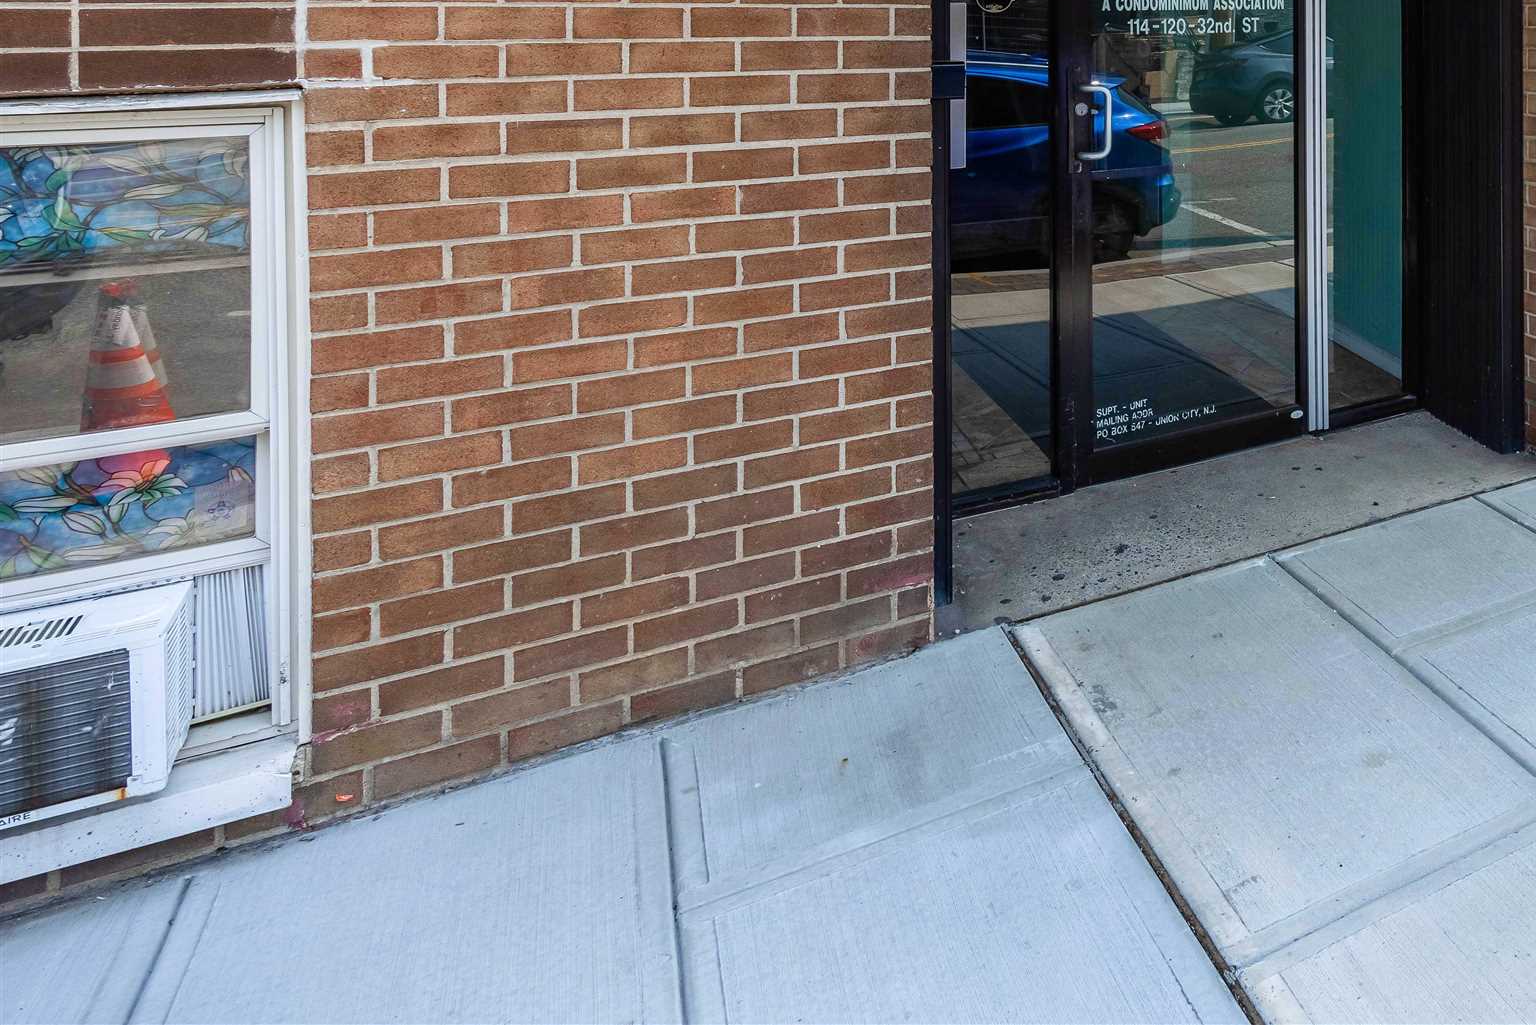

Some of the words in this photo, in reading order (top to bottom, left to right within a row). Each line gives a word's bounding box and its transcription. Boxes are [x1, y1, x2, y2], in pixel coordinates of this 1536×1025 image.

[1241, 16, 1260, 33] ST
[1096, 405, 1120, 418] SUPT.
[1129, 398, 1148, 410] UNIT
[1096, 414, 1129, 429] MAILING
[1096, 429, 1108, 439] PO
[1111, 425, 1128, 436] BOX
[1155, 413, 1179, 426] UNION
